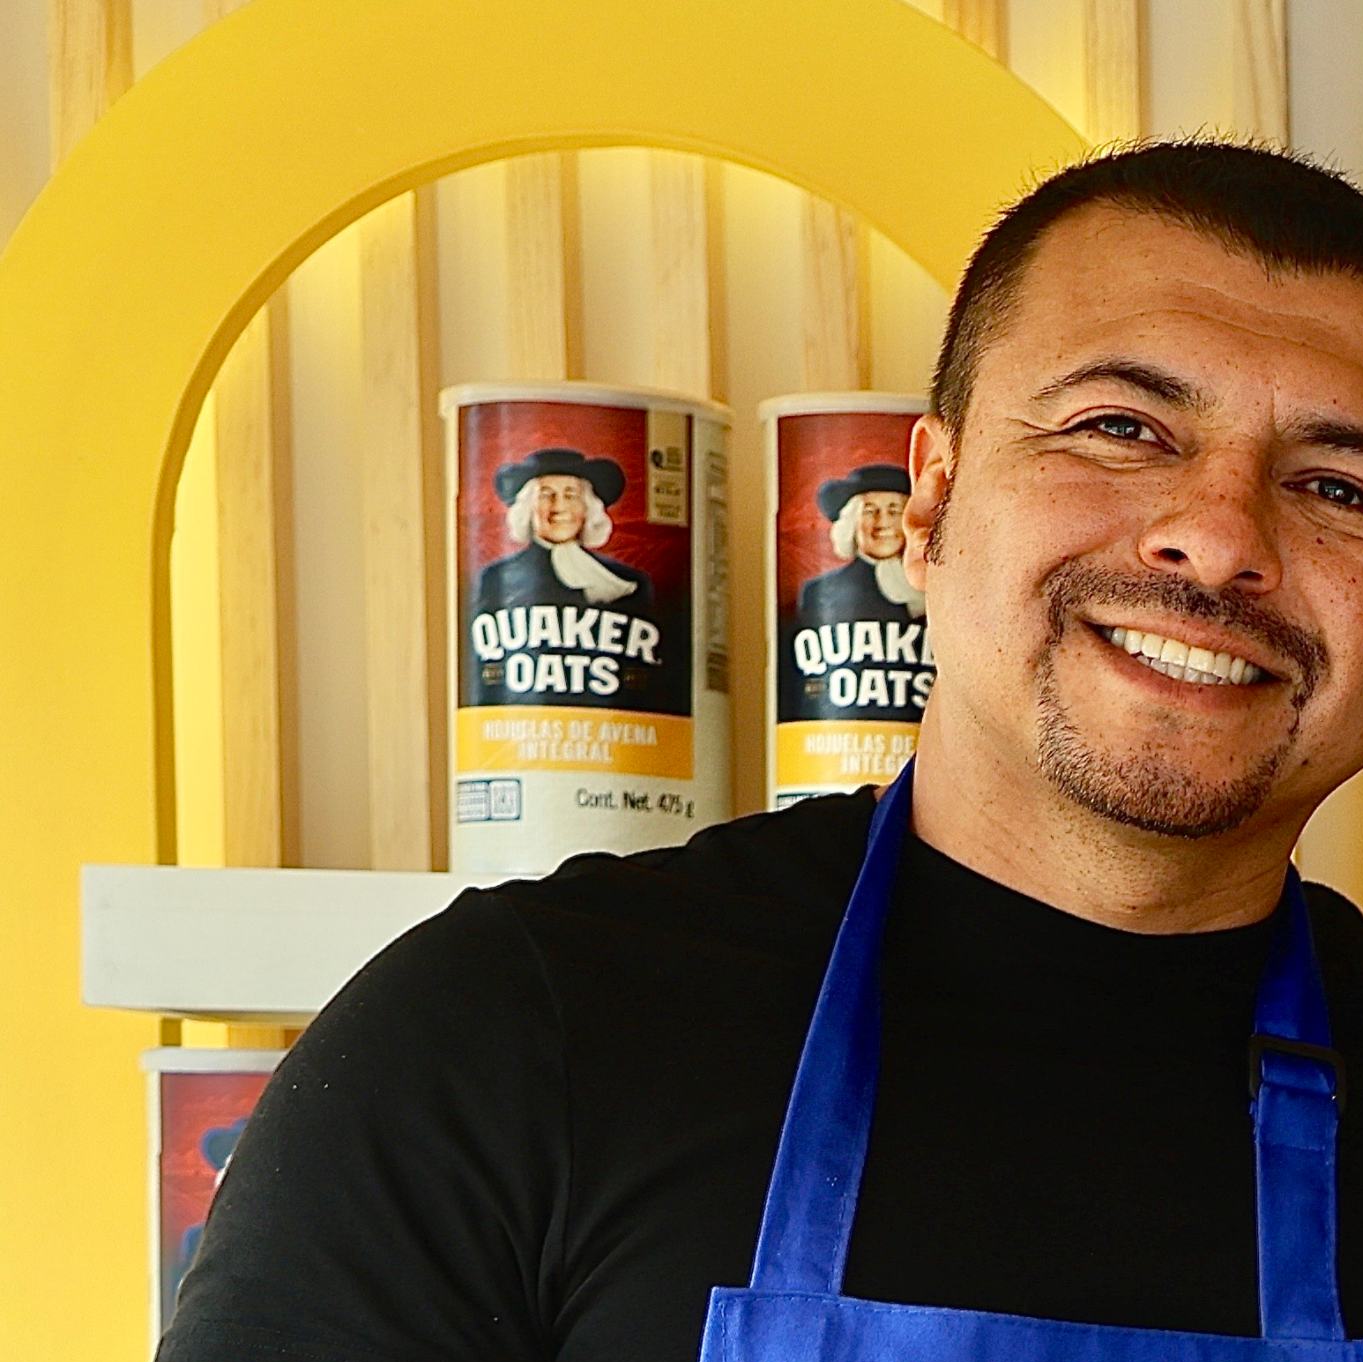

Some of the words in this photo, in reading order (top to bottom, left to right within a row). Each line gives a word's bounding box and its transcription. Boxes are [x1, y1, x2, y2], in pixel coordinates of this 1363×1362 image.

[472, 605, 661, 664] QUAKER
[794, 621, 938, 676] QUAK
[506, 653, 620, 695] OATS
[829, 667, 935, 708] OATS
[518, 741, 613, 764] INTEGRAL
[569, 721, 594, 742] DE
[601, 722, 657, 746] AVENA
